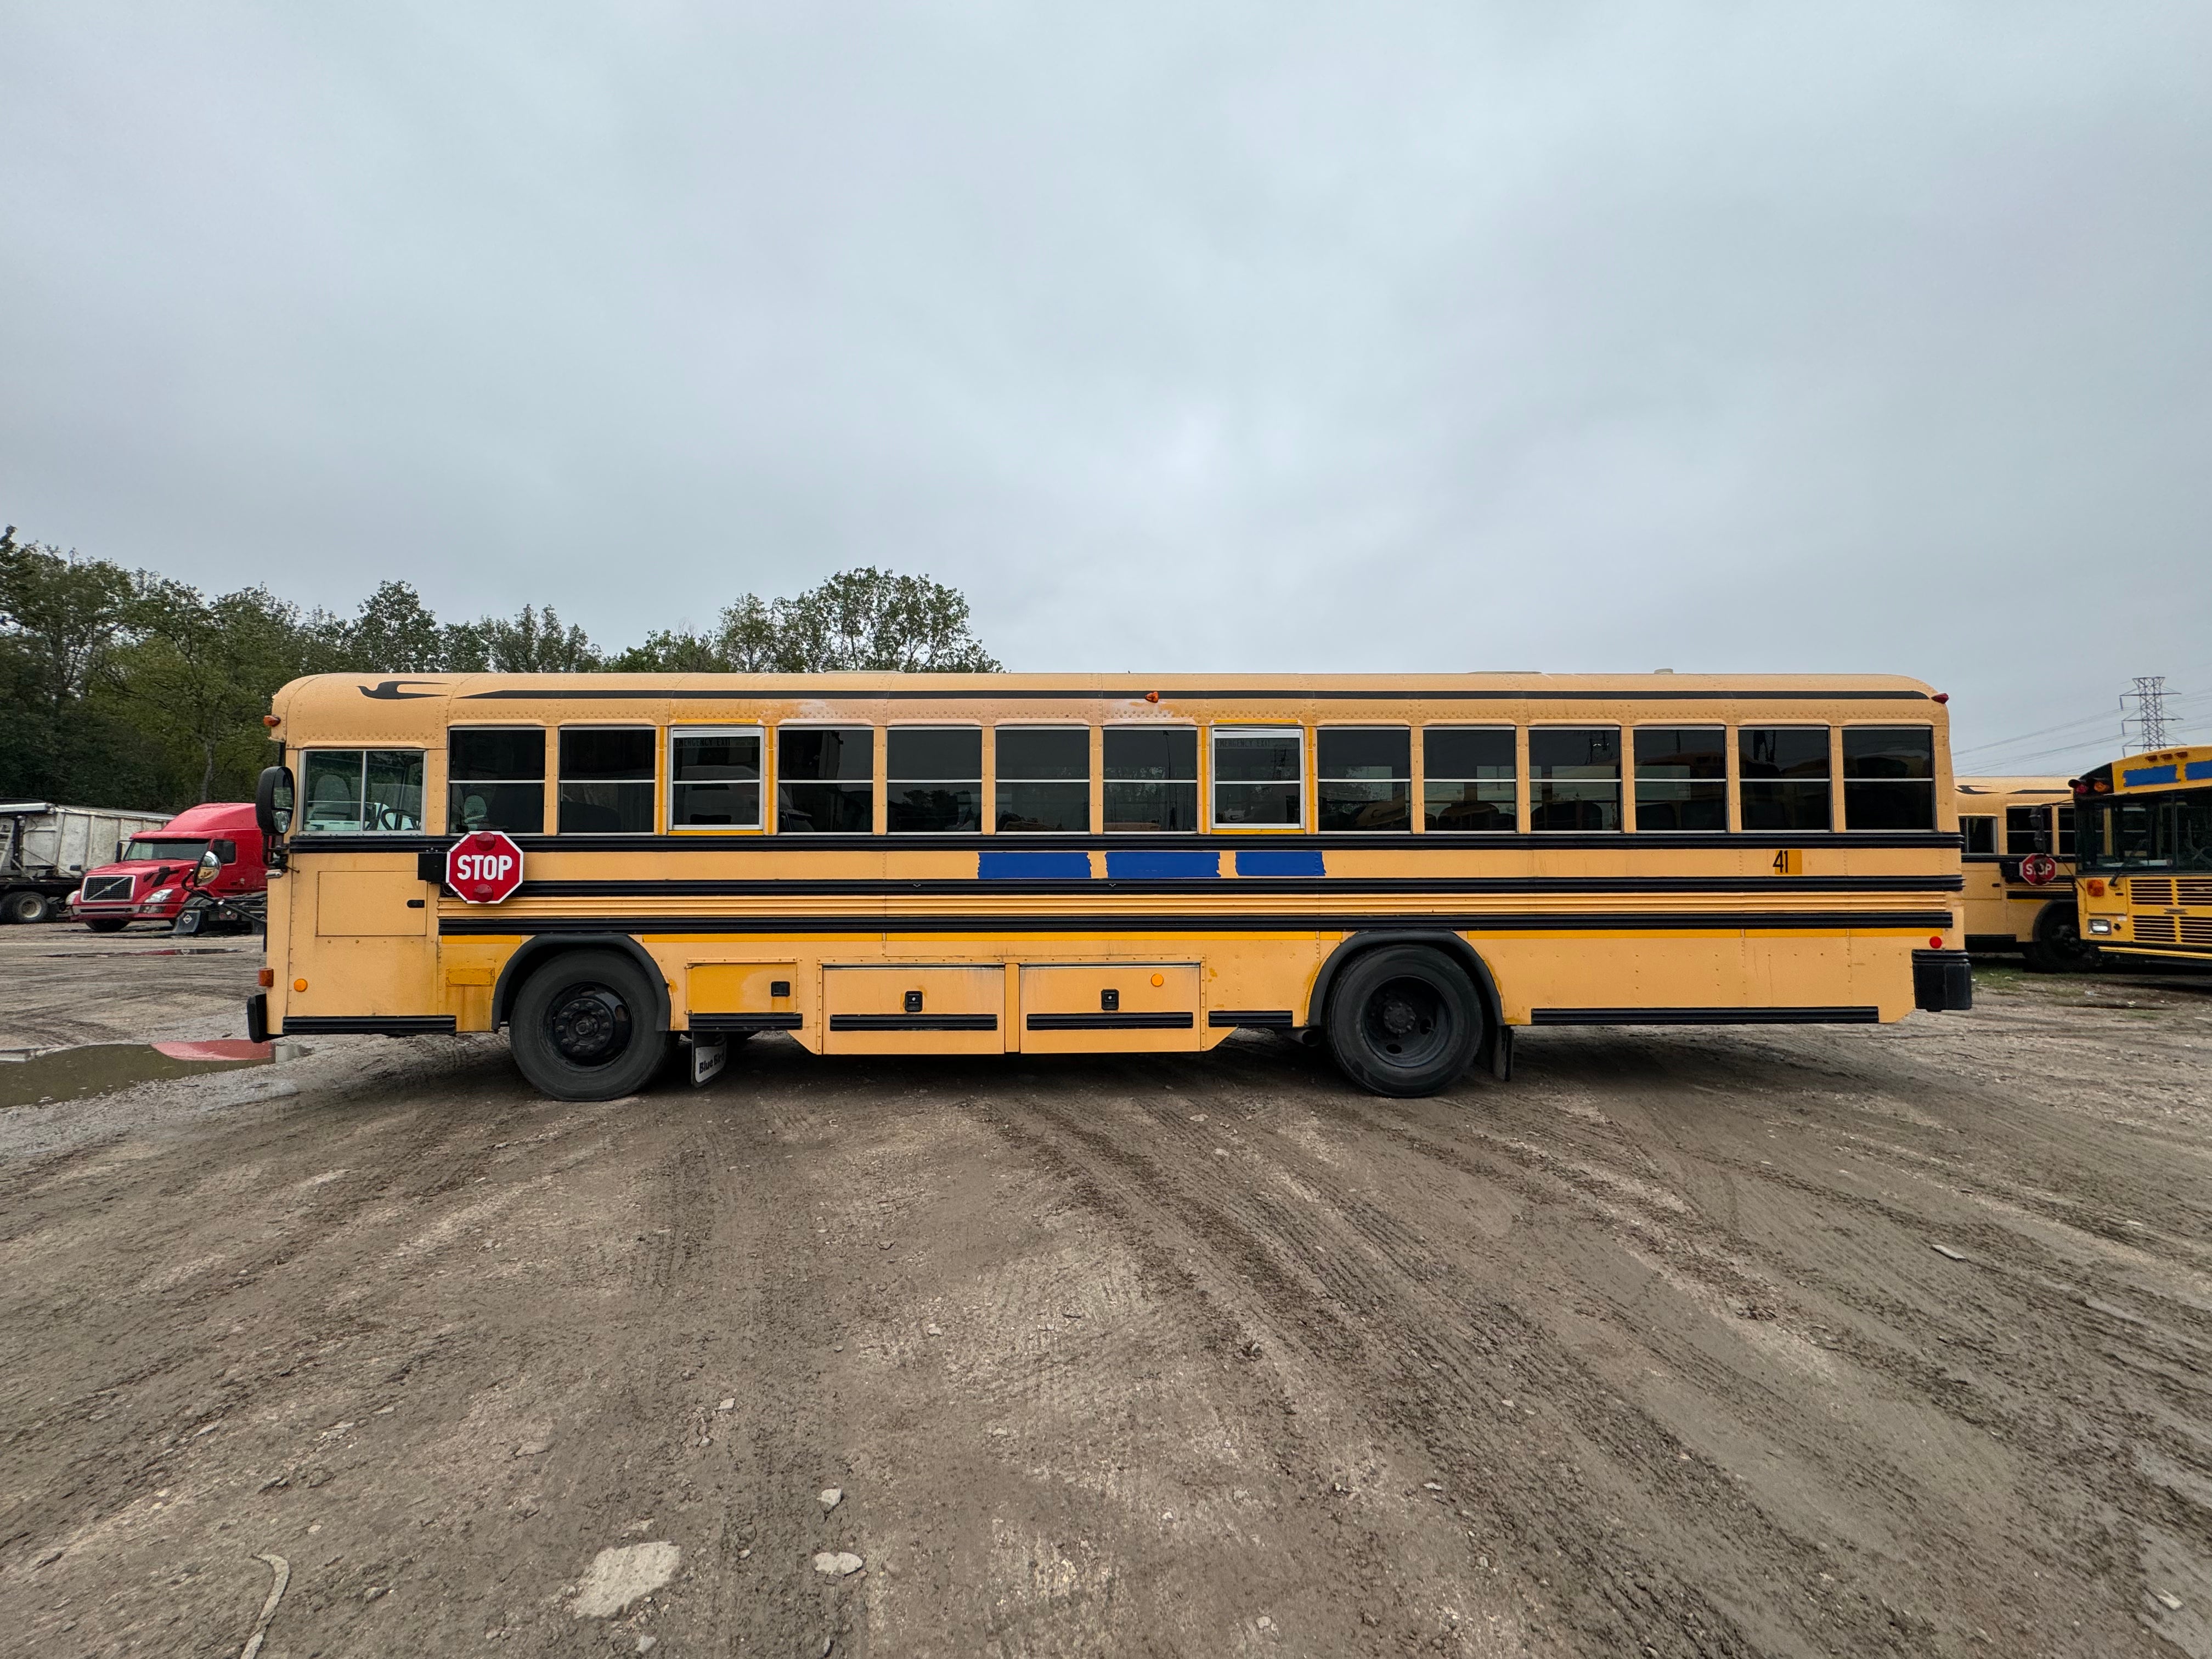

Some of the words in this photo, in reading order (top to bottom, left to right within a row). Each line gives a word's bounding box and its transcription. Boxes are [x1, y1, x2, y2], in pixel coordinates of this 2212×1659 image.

[675, 738, 712, 747] EMERGENCY
[457, 855, 513, 881] STOP
[1773, 850, 1788, 873] 41
[699, 1060, 713, 1074] Blue
